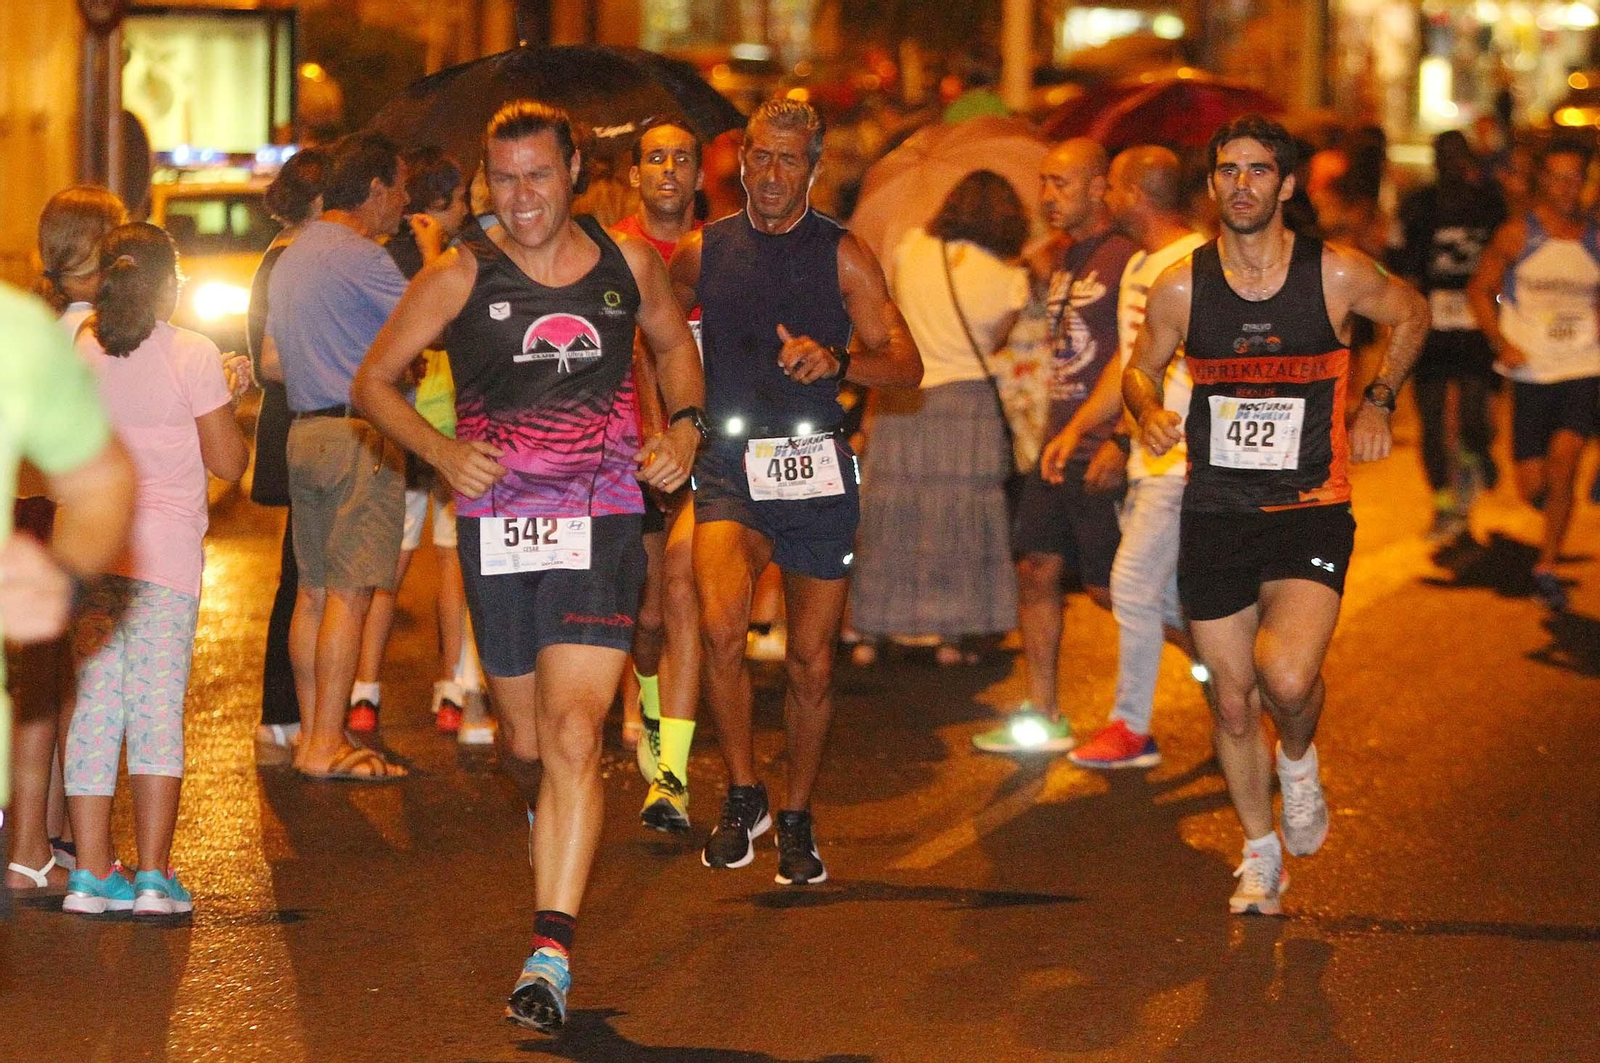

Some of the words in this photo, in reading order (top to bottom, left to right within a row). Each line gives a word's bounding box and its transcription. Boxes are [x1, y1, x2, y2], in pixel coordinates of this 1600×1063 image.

[1235, 411, 1250, 420] DE
[1252, 411, 1291, 420] HUELVA
[1238, 402, 1293, 411] NOCTURNA
[1226, 420, 1275, 447] 422
[774, 447, 786, 457] DE
[767, 455, 814, 482] 488
[503, 517, 558, 547] 542
